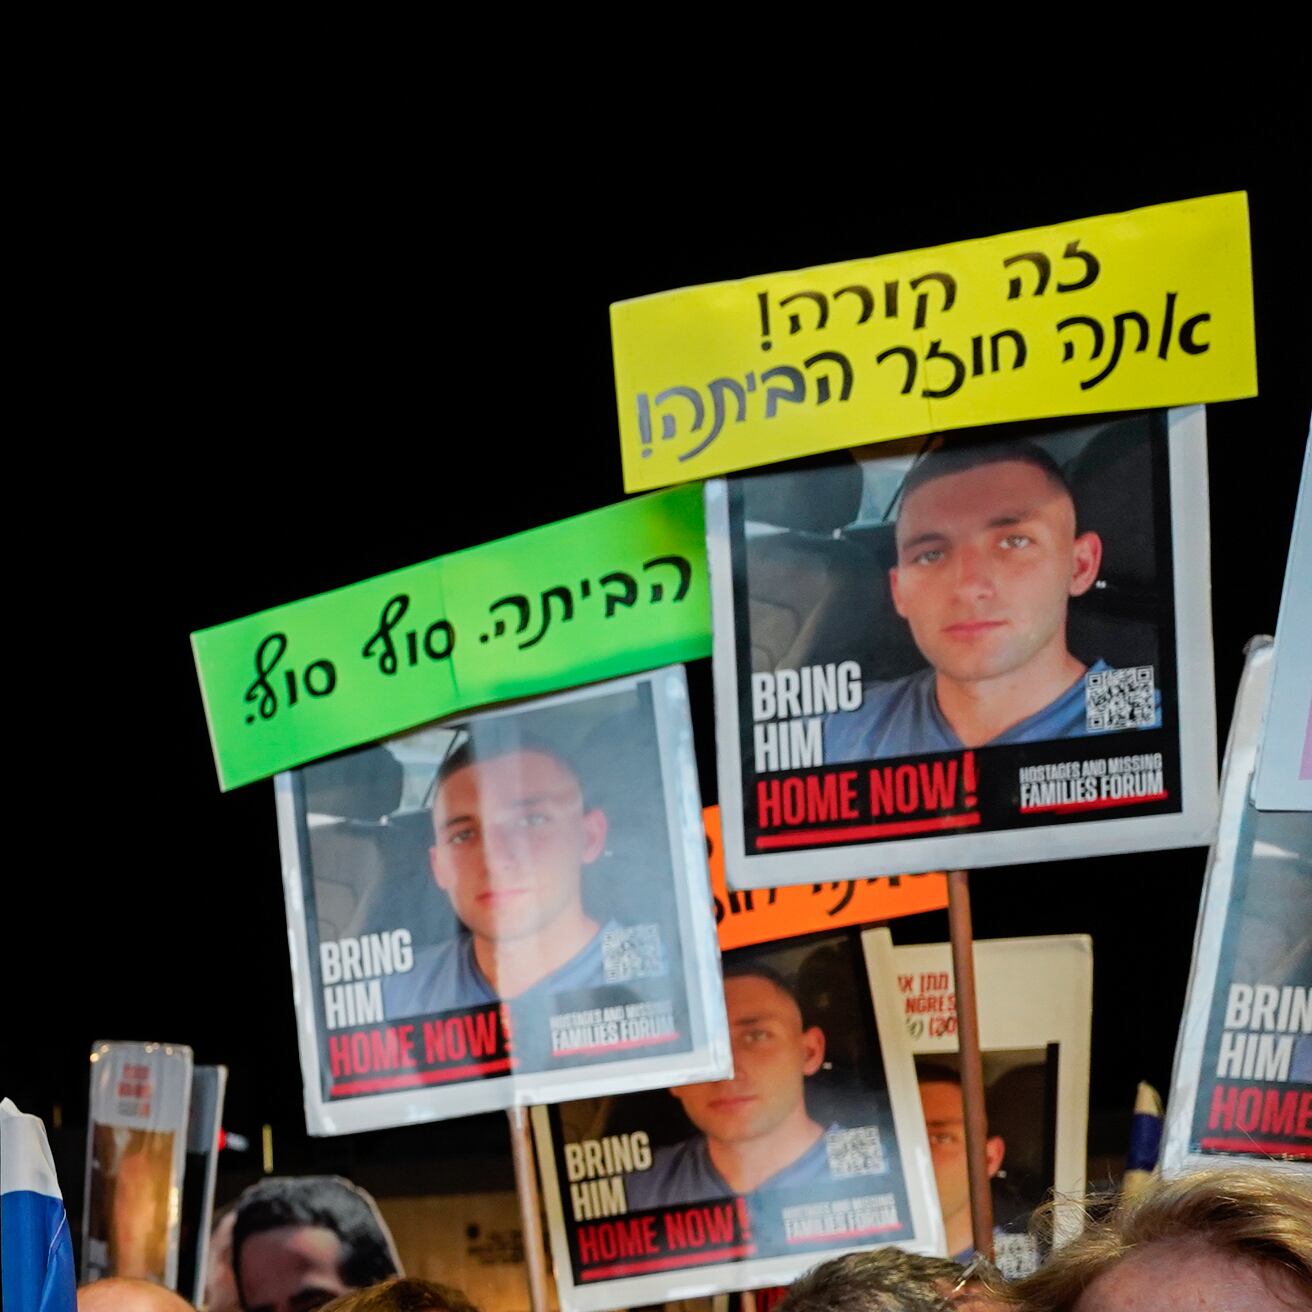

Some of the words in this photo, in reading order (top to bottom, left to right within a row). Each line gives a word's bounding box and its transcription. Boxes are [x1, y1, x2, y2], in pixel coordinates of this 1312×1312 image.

[1002, 239, 1101, 301] זה
[756, 270, 958, 352] קורה!
[875, 326, 1028, 399] חוזר
[1056, 291, 1212, 392] אתה
[636, 350, 855, 463] הביתה!
[479, 555, 692, 650] הביתה.
[362, 594, 456, 675] סוף
[751, 660, 863, 722] BRING
[753, 717, 824, 773] HIM
[1019, 761, 1080, 784] HOSTAGES
[1082, 758, 1107, 778] AND
[1107, 752, 1163, 774] MISSING
[756, 771, 858, 829] HOME
[869, 751, 977, 817] NOW!
[1020, 776, 1097, 809] FAMILIES
[1100, 771, 1163, 799] FORUM
[319, 928, 414, 985] BRING
[325, 978, 385, 1030] HIM
[1223, 983, 1312, 1034] BRIN
[328, 1021, 416, 1077] HOME
[1216, 1030, 1294, 1082] HIM
[565, 1130, 653, 1182] BRING
[570, 1175, 627, 1222] HIM
[578, 1215, 660, 1266] HOME
